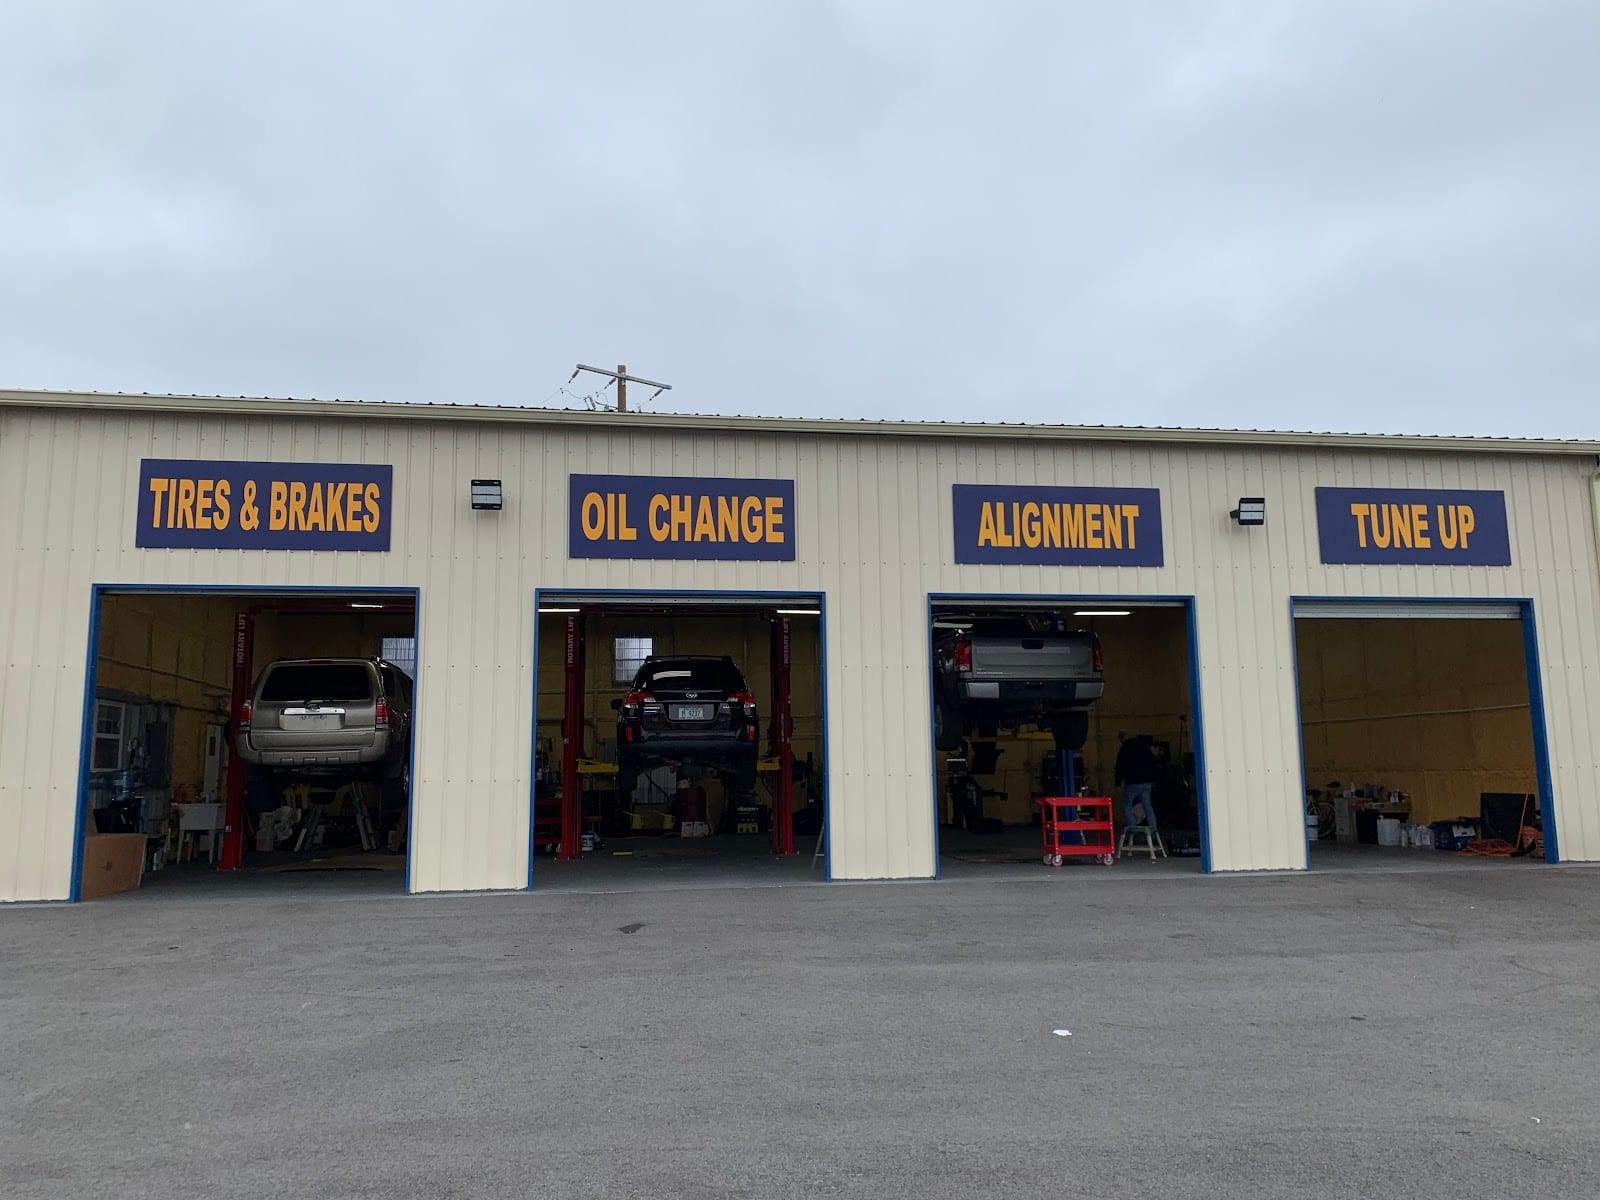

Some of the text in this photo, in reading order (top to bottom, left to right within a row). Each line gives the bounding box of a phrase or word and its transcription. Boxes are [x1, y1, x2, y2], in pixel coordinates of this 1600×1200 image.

[150, 478, 380, 533] TIRES & BRAKES
[582, 491, 785, 543] OIL CHANGE
[977, 502, 1139, 550] ALIGNMENT
[1351, 503, 1475, 549] TUNE UP
[236, 613, 246, 664] ROTARY LIFT
